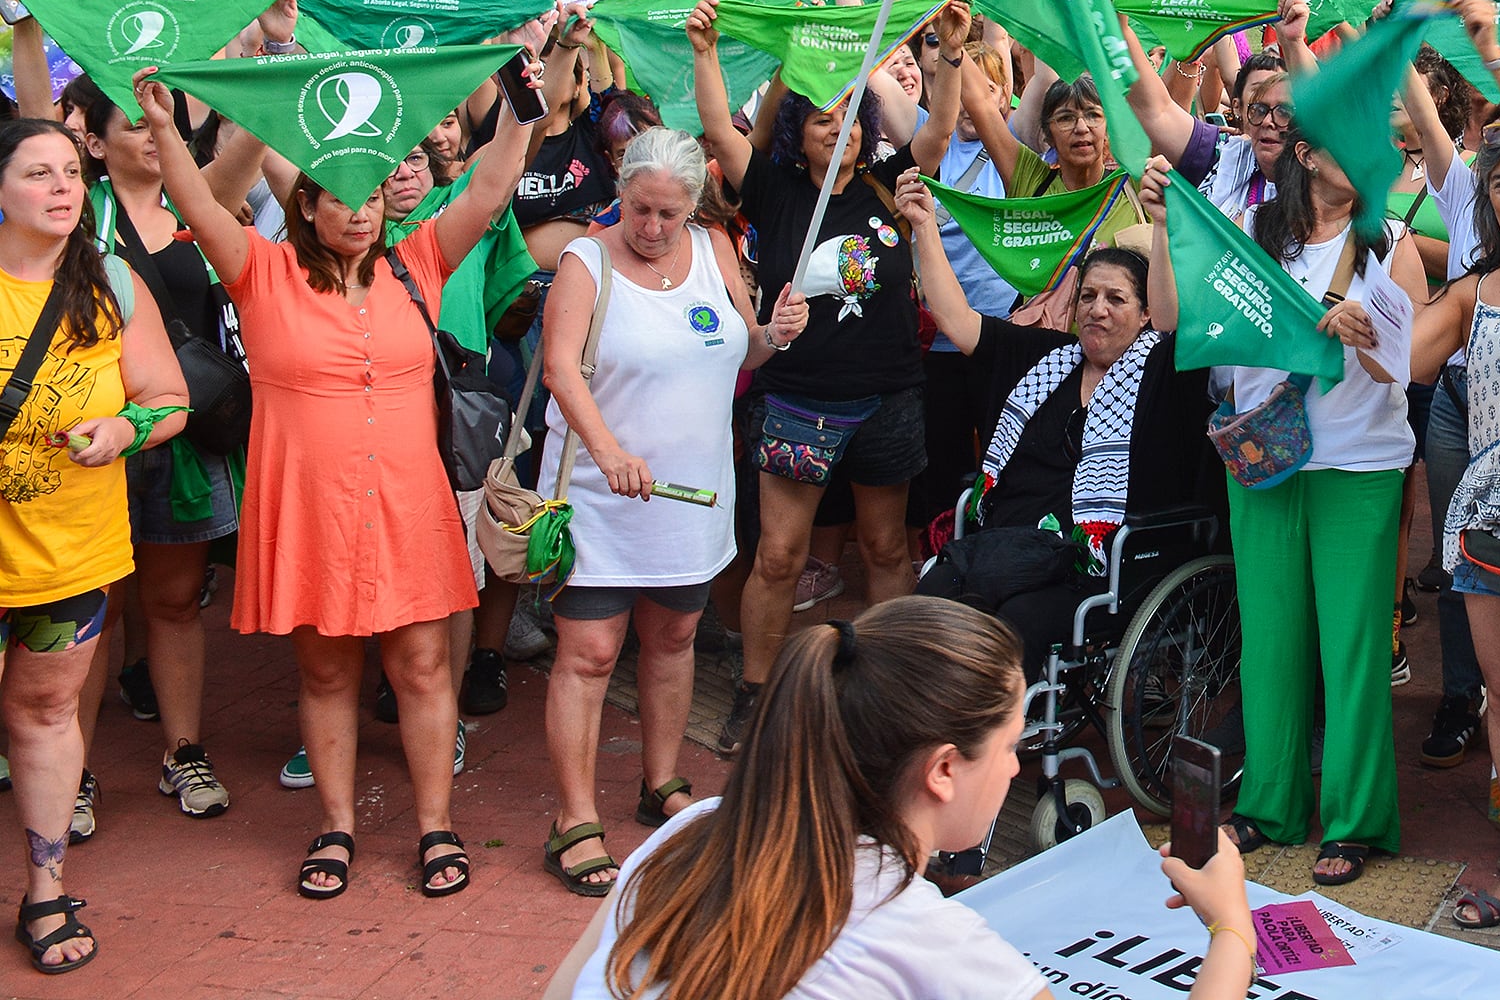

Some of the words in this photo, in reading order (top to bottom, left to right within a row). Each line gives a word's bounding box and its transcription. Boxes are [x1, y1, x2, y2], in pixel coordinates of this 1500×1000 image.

[270, 53, 308, 64] Aborto
[320, 61, 348, 74] decidir,
[305, 74, 319, 89] para
[350, 60, 397, 89] anticonceptivo
[298, 88, 307, 112] sexual
[394, 88, 402, 106] para
[397, 107, 402, 116] no
[298, 113, 320, 150] Educación
[385, 118, 402, 143] abortar
[310, 152, 332, 170] aborto
[332, 148, 350, 158] legal
[378, 151, 396, 165] morir
[1004, 210, 1054, 220] LEGAL,
[1003, 220, 1063, 233] SEGURO,
[992, 234, 1001, 246] Ley
[1002, 230, 1073, 247] GRATUITO.
[1204, 268, 1217, 284] Ley
[1231, 257, 1273, 302] LEGAL,
[1221, 267, 1273, 319] SEGURO,
[1213, 279, 1273, 338] GRATUITO.
[1257, 912, 1285, 941] PAOLA
[1275, 941, 1302, 965] ORTÍZ!
[1276, 921, 1297, 942] PARA
[1286, 915, 1324, 954] ¡LIBERTAD
